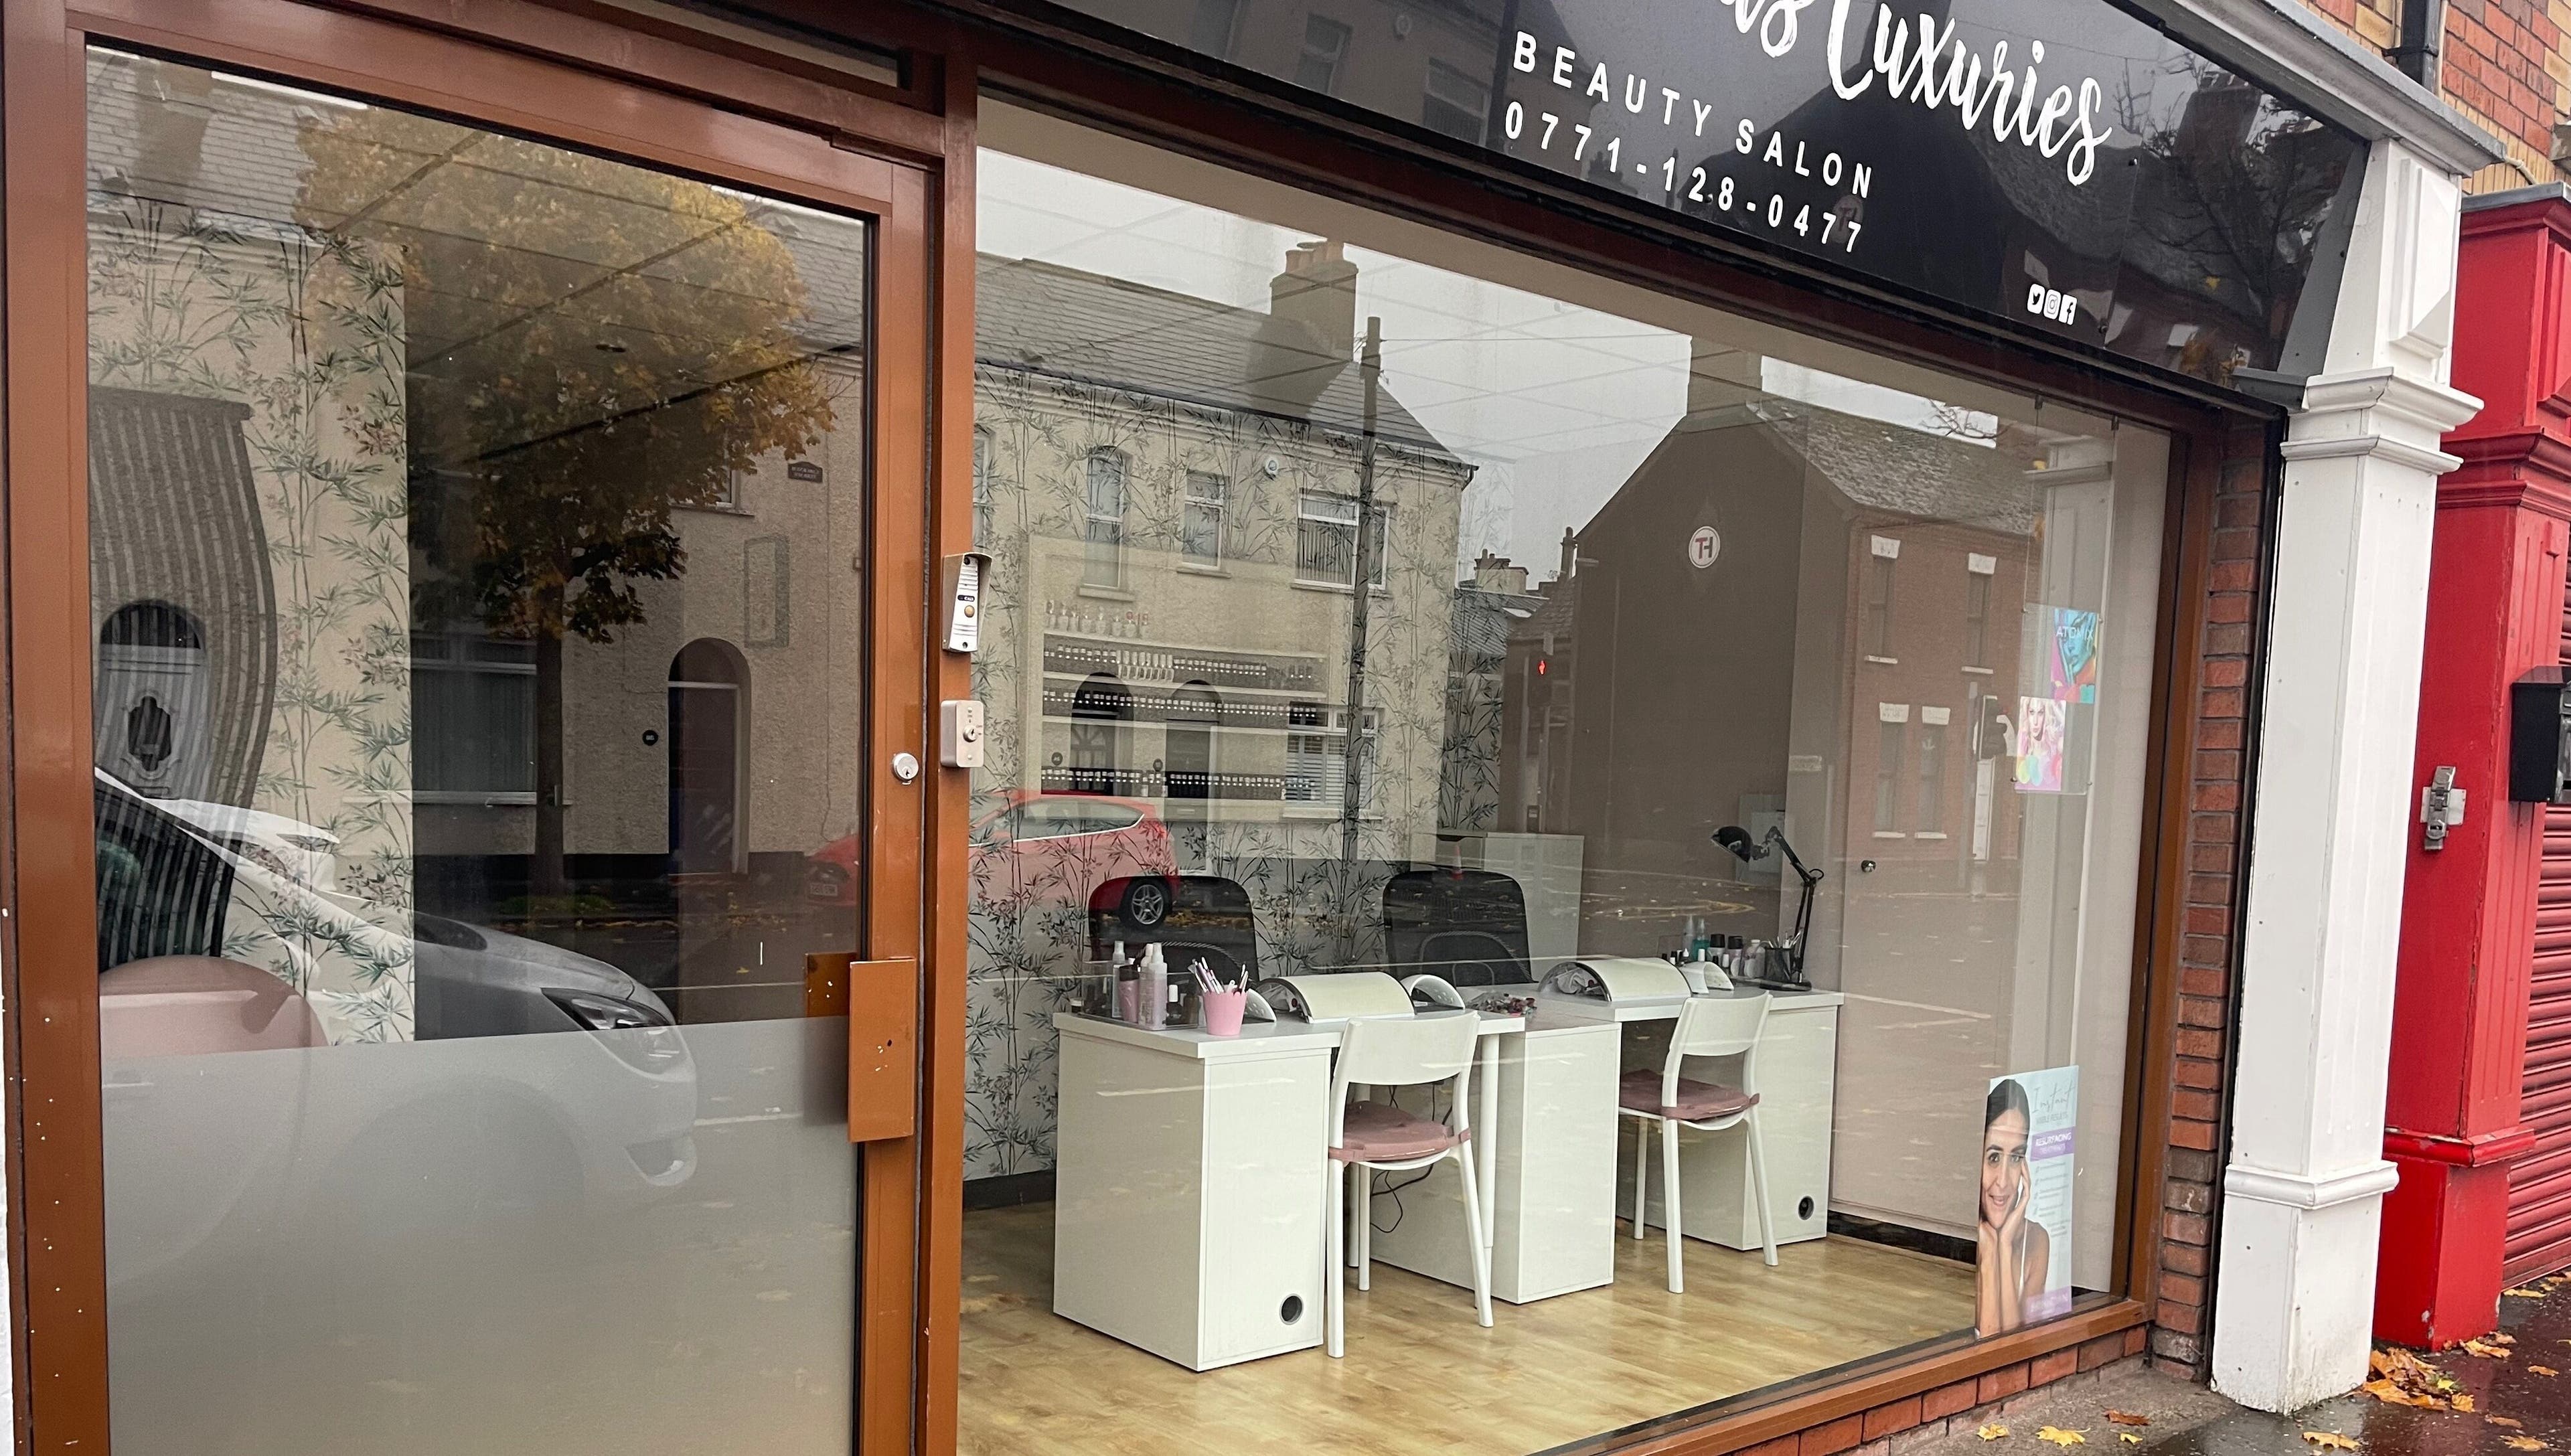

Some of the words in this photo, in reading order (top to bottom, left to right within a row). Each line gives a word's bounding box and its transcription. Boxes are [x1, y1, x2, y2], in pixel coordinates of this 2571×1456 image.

[1504, 100, 1862, 253] 0771-128-0477
[1513, 31, 1713, 137] BEAUTY
[1735, 118, 1872, 199] SALON
[1826, 0, 2112, 186] Luxuries
